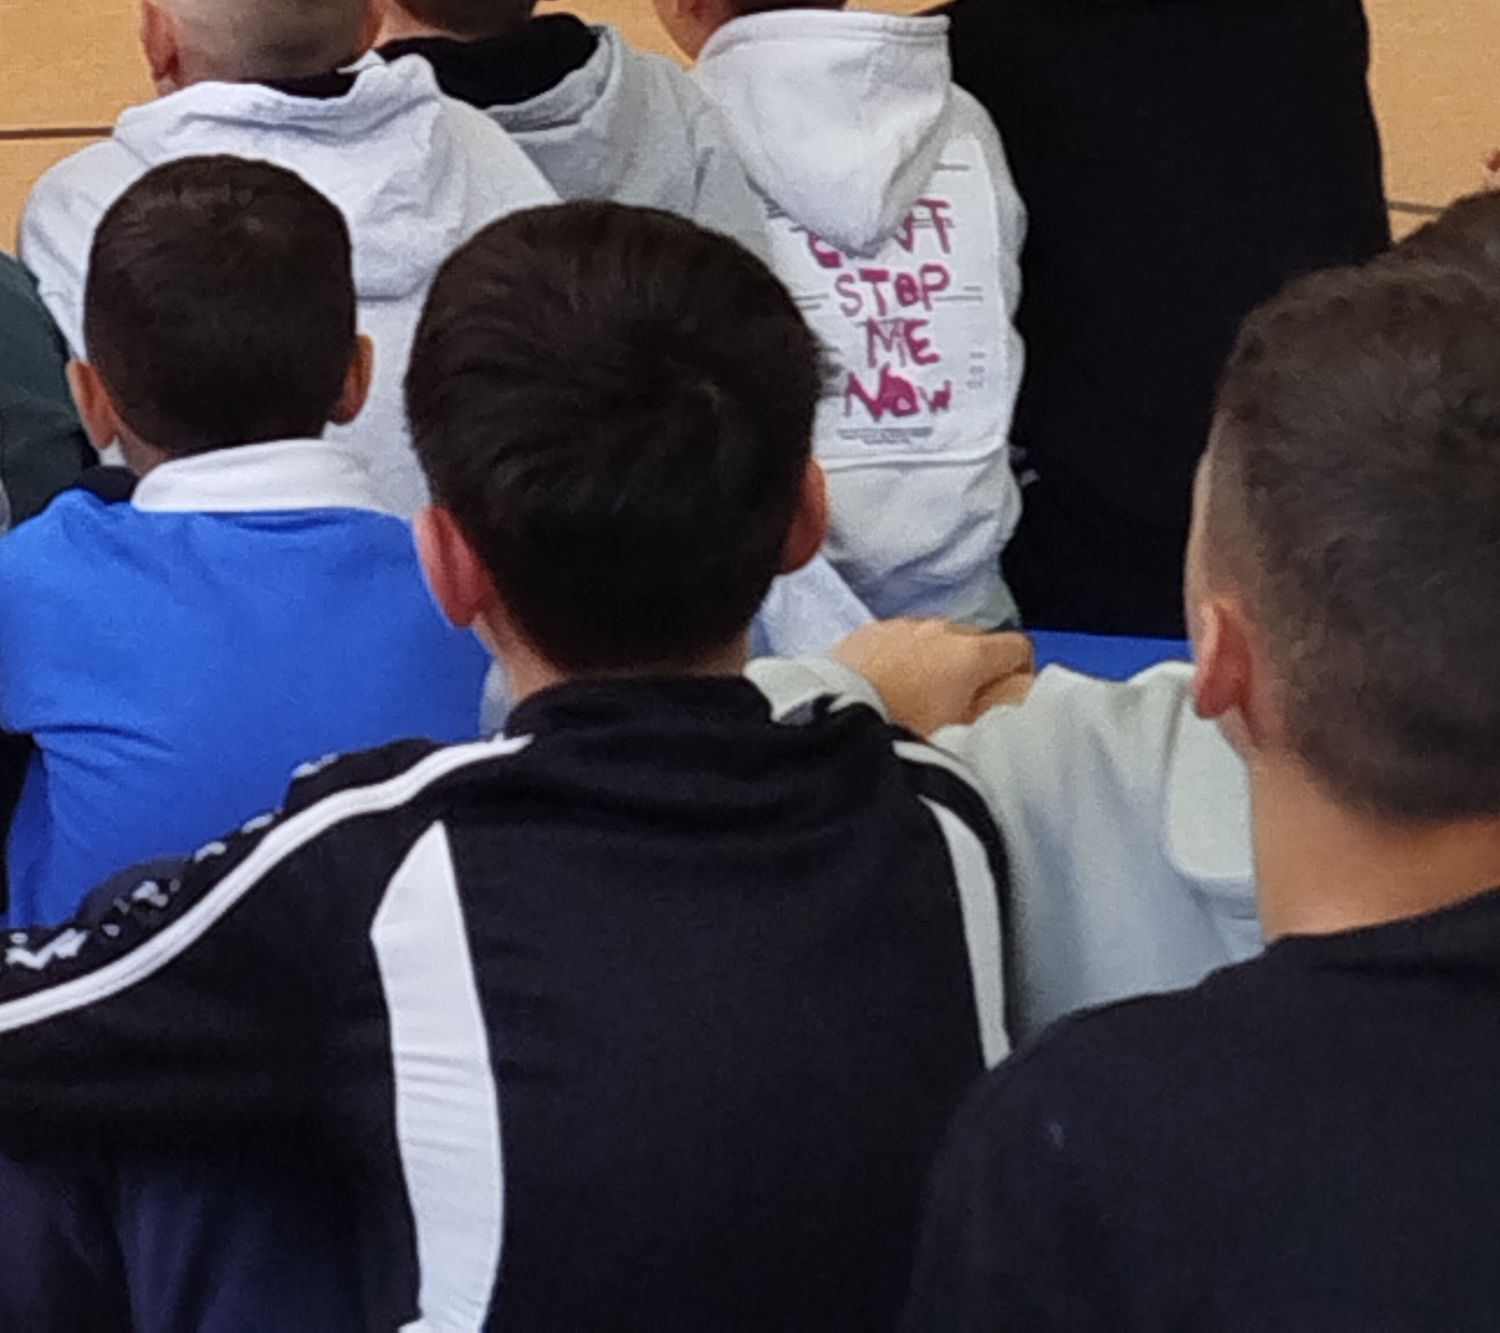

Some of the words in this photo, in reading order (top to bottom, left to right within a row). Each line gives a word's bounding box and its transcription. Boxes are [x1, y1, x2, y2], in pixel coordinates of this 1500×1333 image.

[834, 262, 952, 319] STOP
[866, 315, 941, 367] ME
[844, 361, 952, 422] NOW
